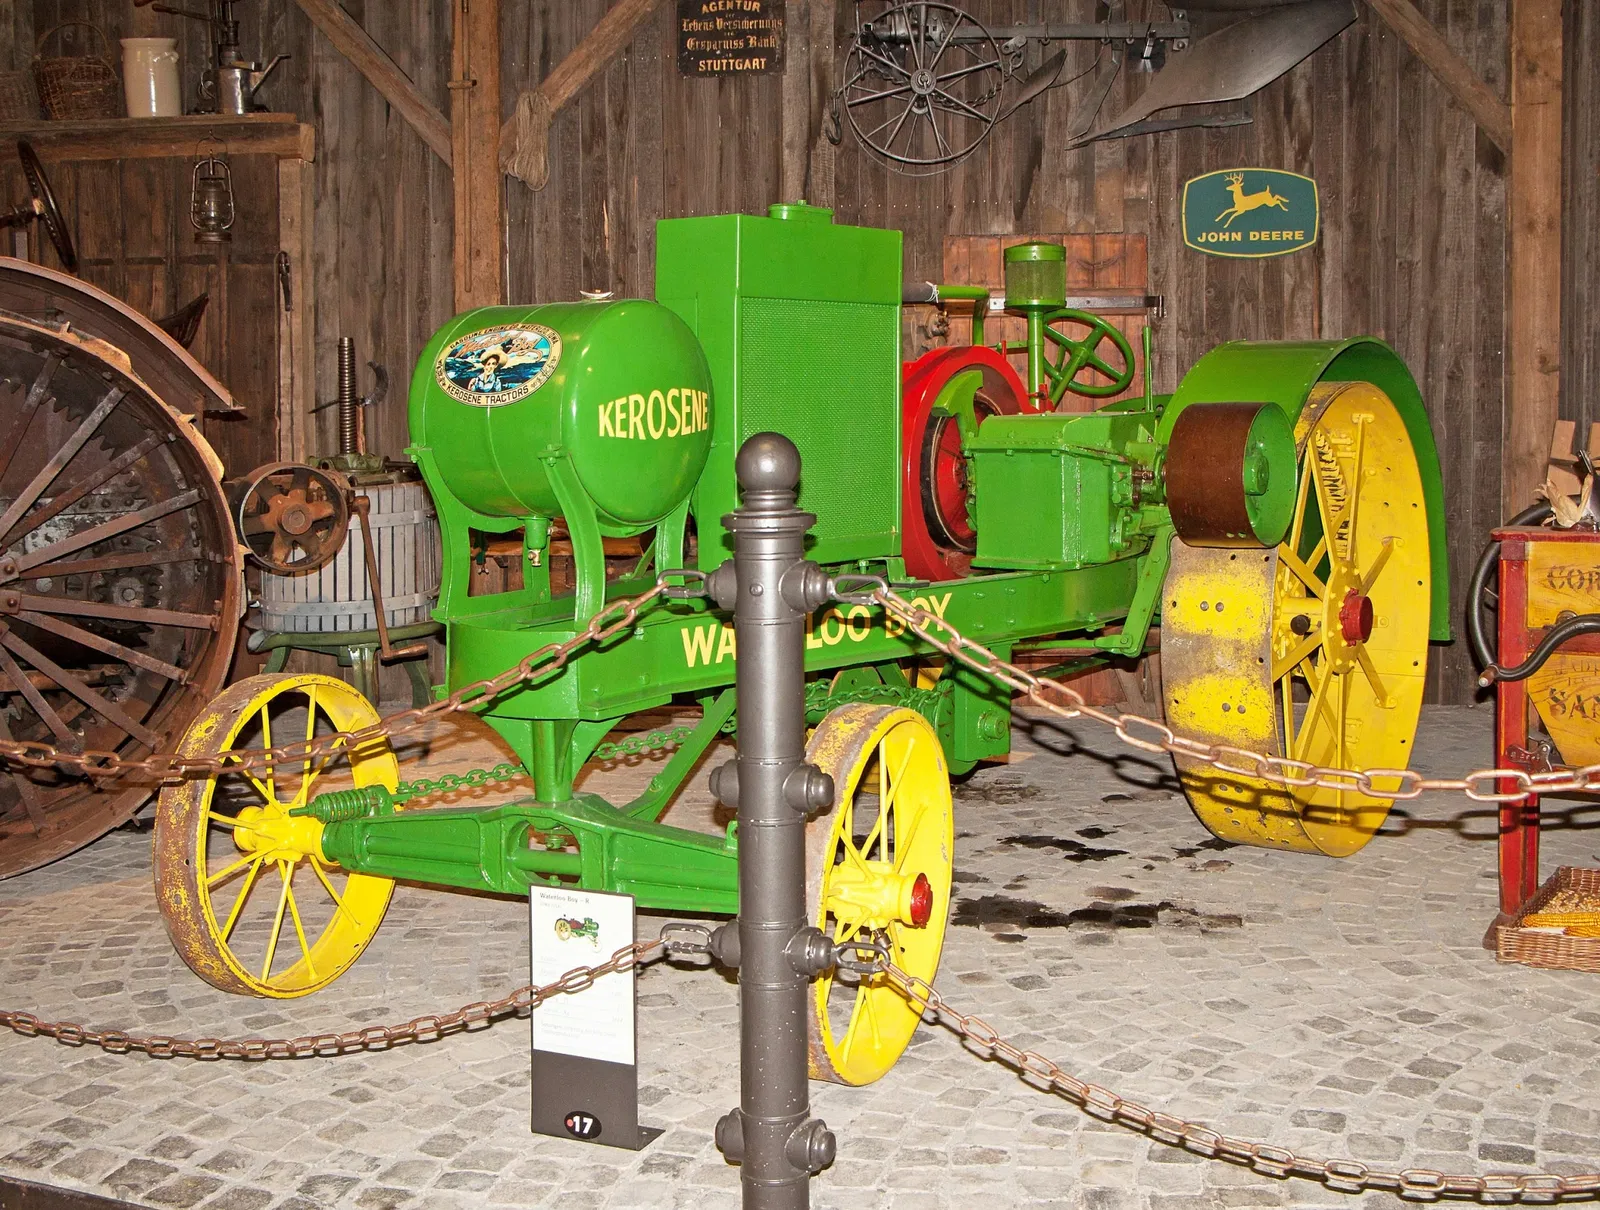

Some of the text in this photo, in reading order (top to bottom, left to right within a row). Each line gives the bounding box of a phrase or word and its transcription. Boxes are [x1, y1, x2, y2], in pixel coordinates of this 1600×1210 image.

[701, 0, 761, 14] AGENTUR
[698, 58, 767, 72] STUTTGART
[1197, 230, 1304, 243] JOHN DEERE
[446, 383, 529, 404] KEROSENE TRACTORS
[598, 388, 708, 440] KEROSENE
[681, 592, 952, 668] WALOO BOY
[572, 1115, 594, 1134] 17
